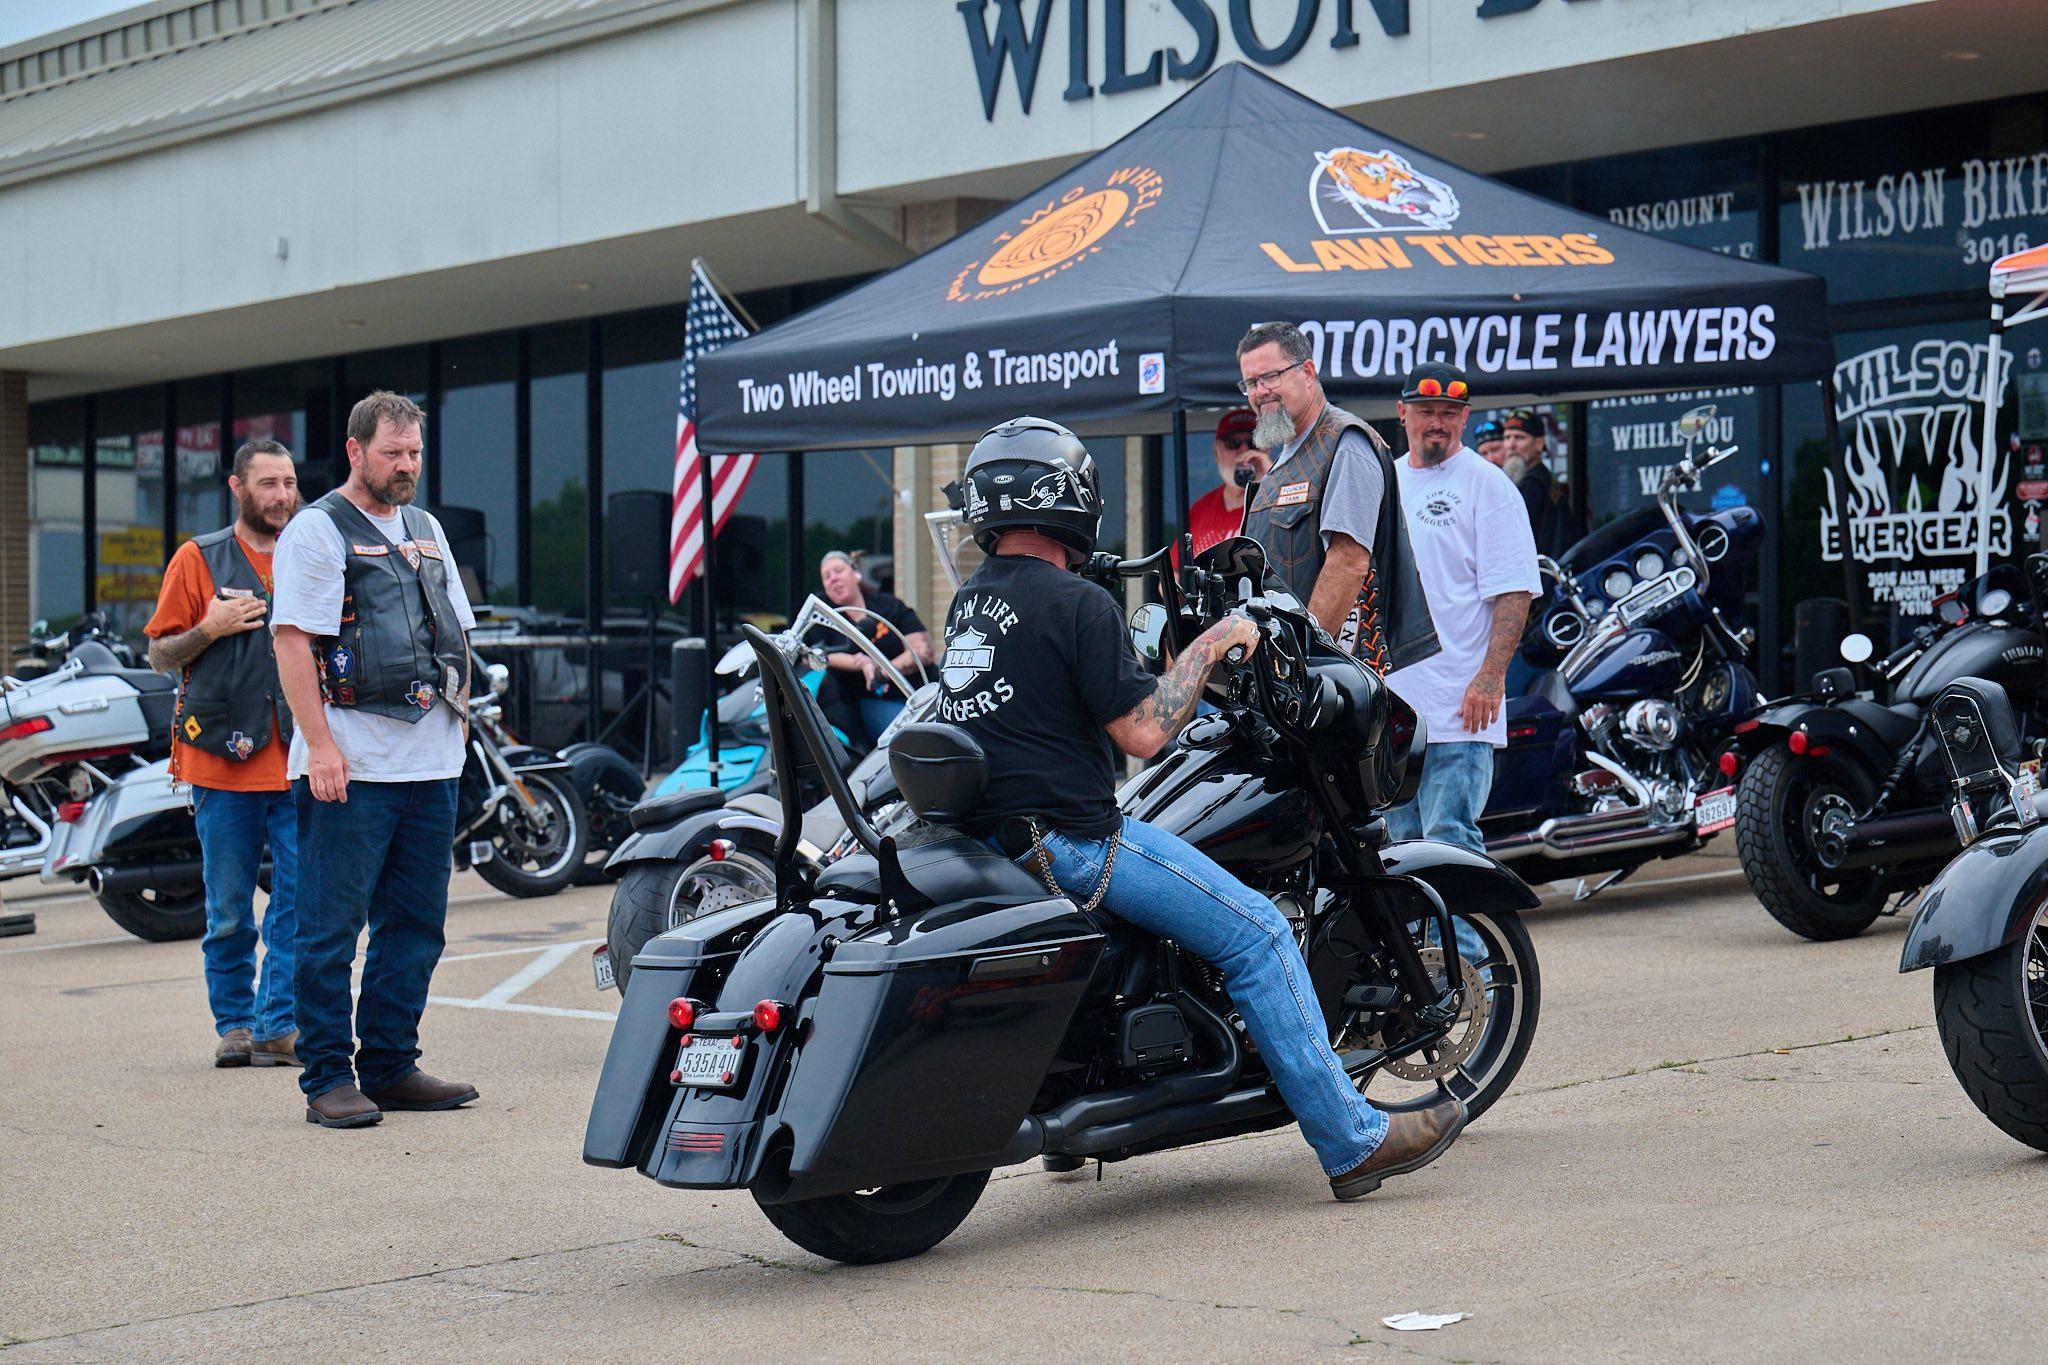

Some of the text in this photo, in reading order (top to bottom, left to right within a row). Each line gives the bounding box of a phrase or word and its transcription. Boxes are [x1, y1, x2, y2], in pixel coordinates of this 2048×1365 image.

[1797, 167, 1946, 250] WILSON
[1260, 233, 1616, 273] LAW TIGERS
[1251, 304, 1777, 379] OTORCYCLE LAWYERS
[738, 378, 785, 414] Two
[788, 365, 861, 408] Wheel
[867, 357, 956, 402] Towing
[962, 351, 984, 390] &
[988, 338, 1120, 390] Transport
[1834, 339, 2014, 422] WILSON
[1611, 421, 1684, 452] WHILE
[1415, 510, 1456, 527] BAGGERS
[1820, 512, 1914, 563] BKER
[981, 595, 1019, 636] LIFE
[937, 677, 1015, 722] AGGERS
